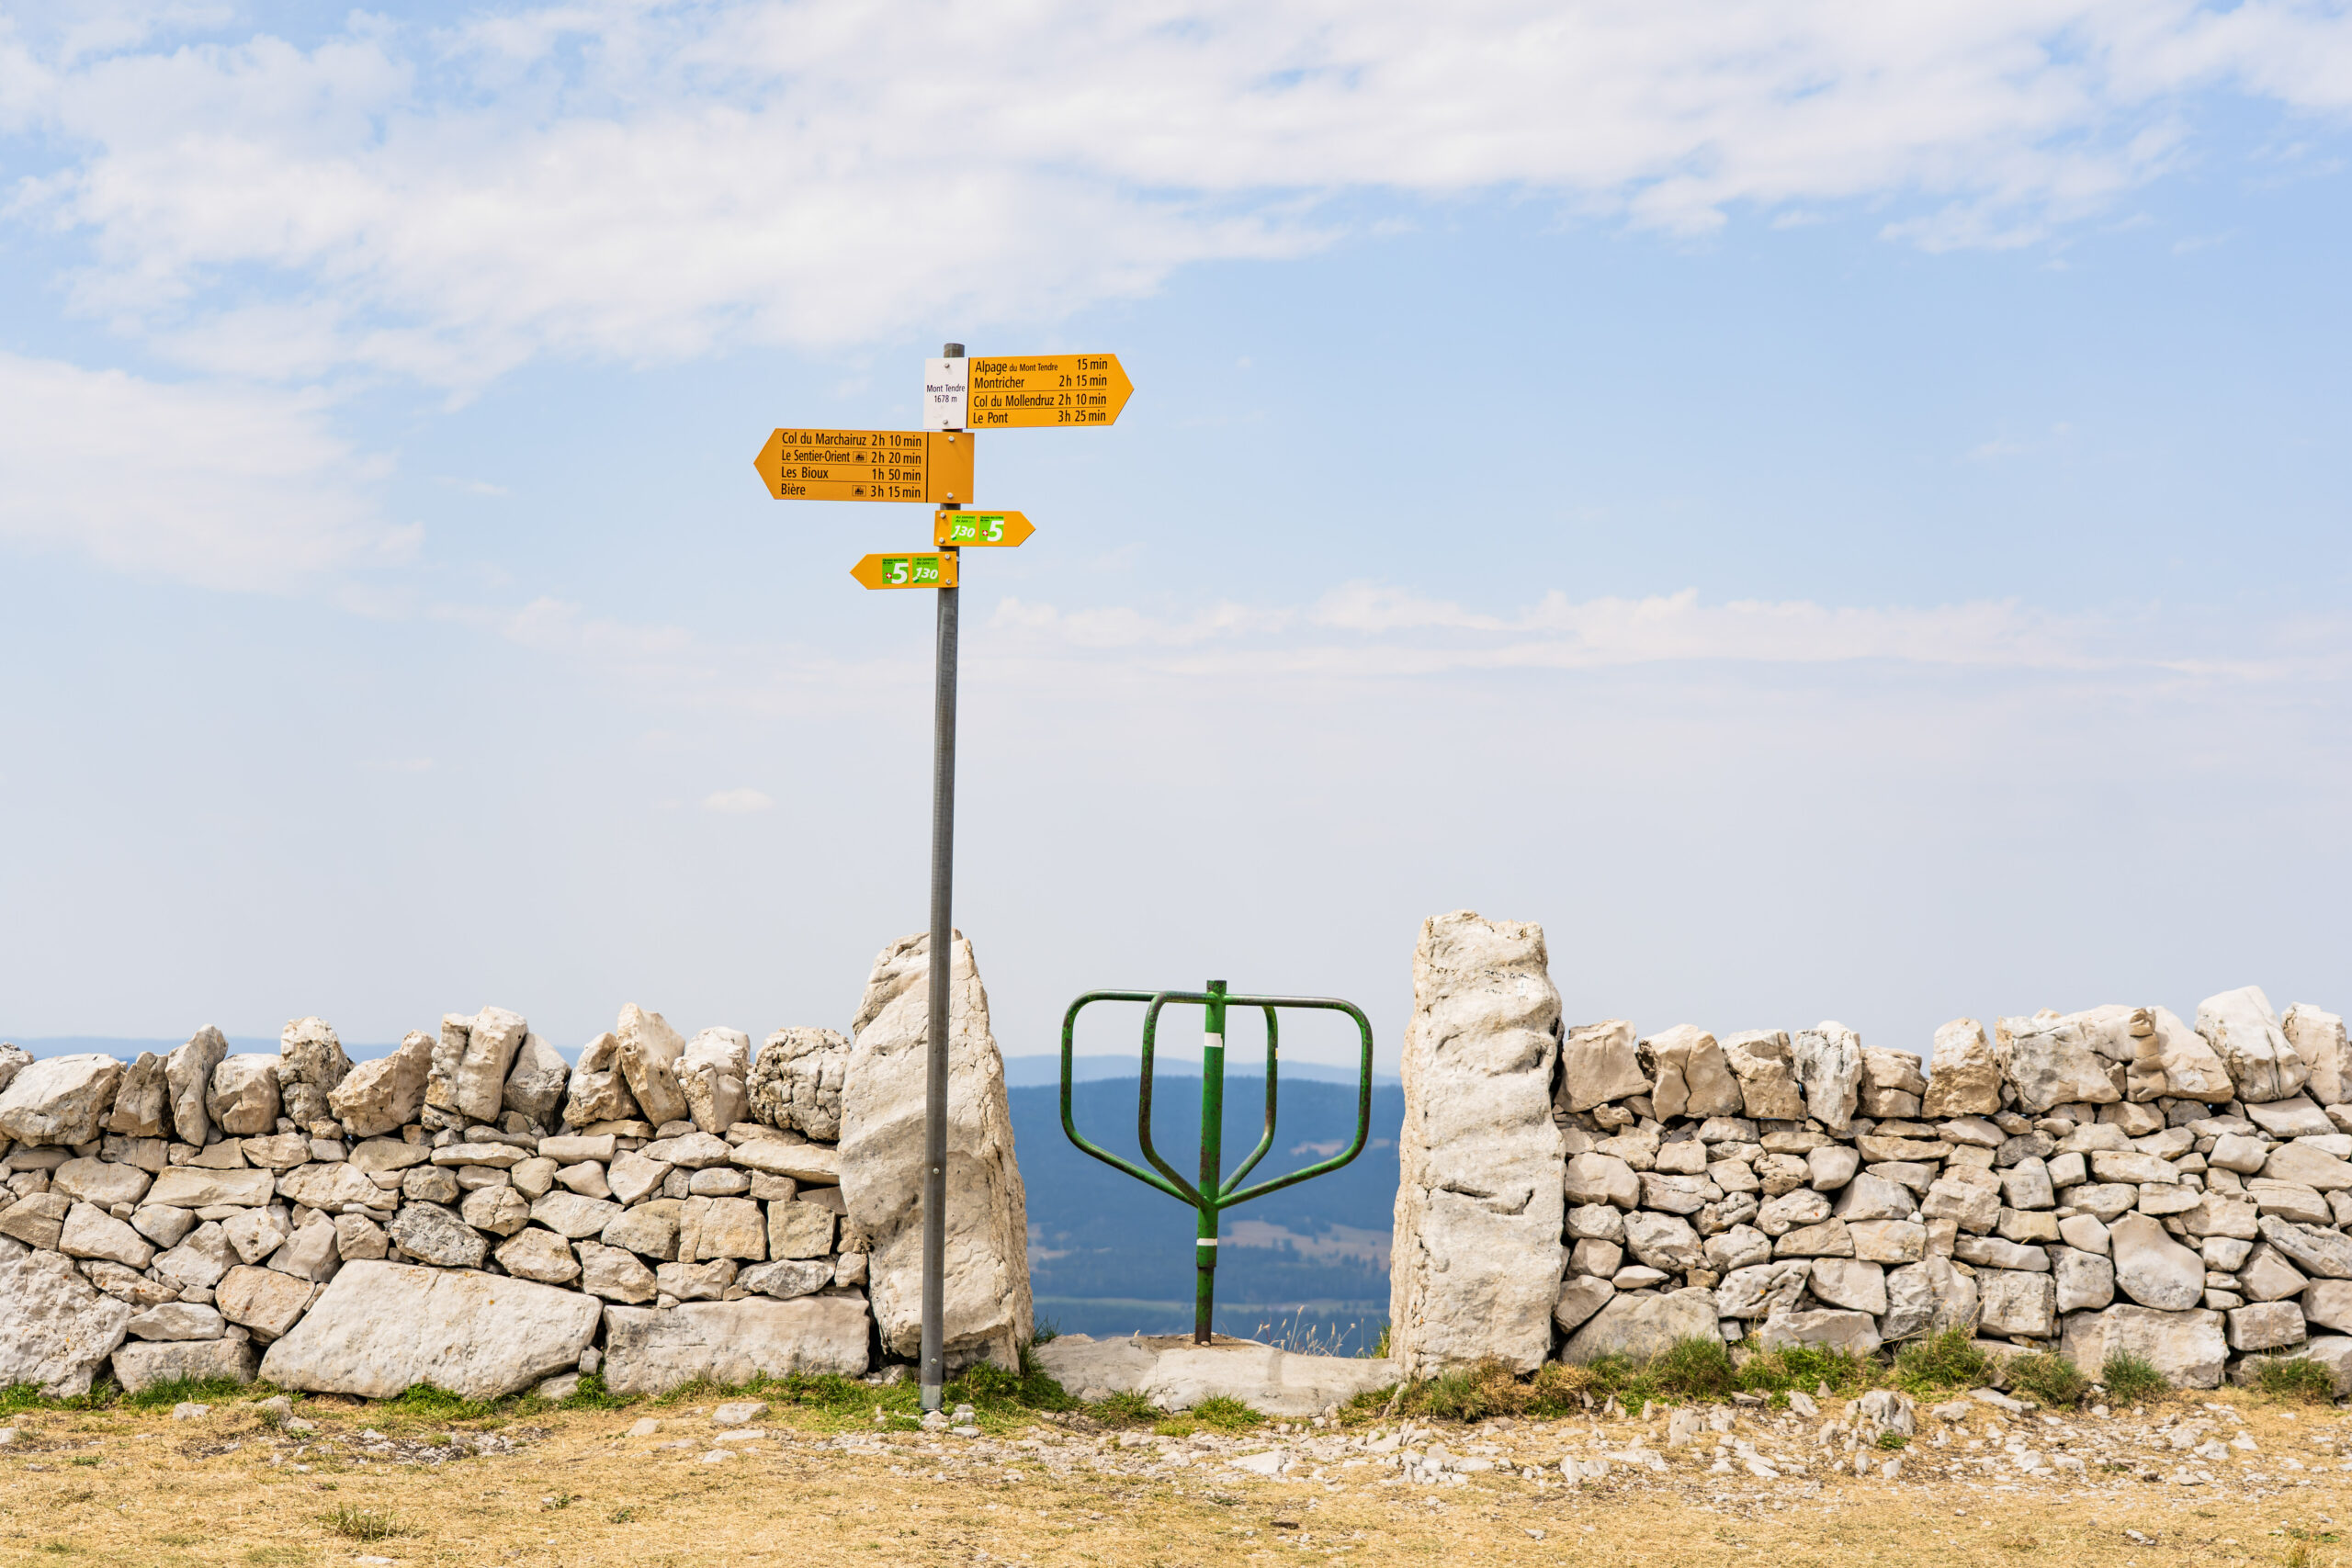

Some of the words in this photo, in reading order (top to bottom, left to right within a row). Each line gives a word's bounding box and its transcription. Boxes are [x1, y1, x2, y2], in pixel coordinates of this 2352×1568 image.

[976, 360, 1007, 375] Alpage
[1038, 363, 1057, 371] Tendre
[1077, 359, 1088, 370] 15
[1090, 357, 1107, 370] min
[945, 384, 966, 392] Tendre
[975, 376, 1024, 388] Montricher
[1077, 375, 1087, 386] 15
[1090, 374, 1107, 386] min
[974, 396, 987, 407] Col
[991, 396, 1001, 407] du
[1005, 394, 1054, 406] Mollendruz
[1076, 394, 1086, 405] 10
[1089, 393, 1106, 404] min
[974, 412, 983, 423] Le
[988, 412, 1008, 423] Pont
[1075, 411, 1086, 422] 25
[1089, 410, 1105, 422] min
[782, 433, 797, 445] Col
[800, 433, 811, 445] du
[816, 434, 866, 446] Marchairuz
[889, 434, 900, 446] 10
[903, 435, 922, 446] min
[782, 450, 791, 461] Le
[794, 450, 850, 462] Sentier-Orient
[889, 452, 900, 463] 20
[903, 452, 921, 464] min
[782, 466, 797, 478] Les
[802, 467, 828, 479] Bioux
[888, 468, 900, 480] 50
[903, 469, 921, 481] min
[781, 483, 806, 495] Bière
[888, 486, 899, 497] 15
[902, 486, 921, 498] min
[955, 525, 976, 538] 130
[987, 520, 1005, 542] 5
[891, 563, 909, 584] 5
[916, 567, 938, 580] 130
